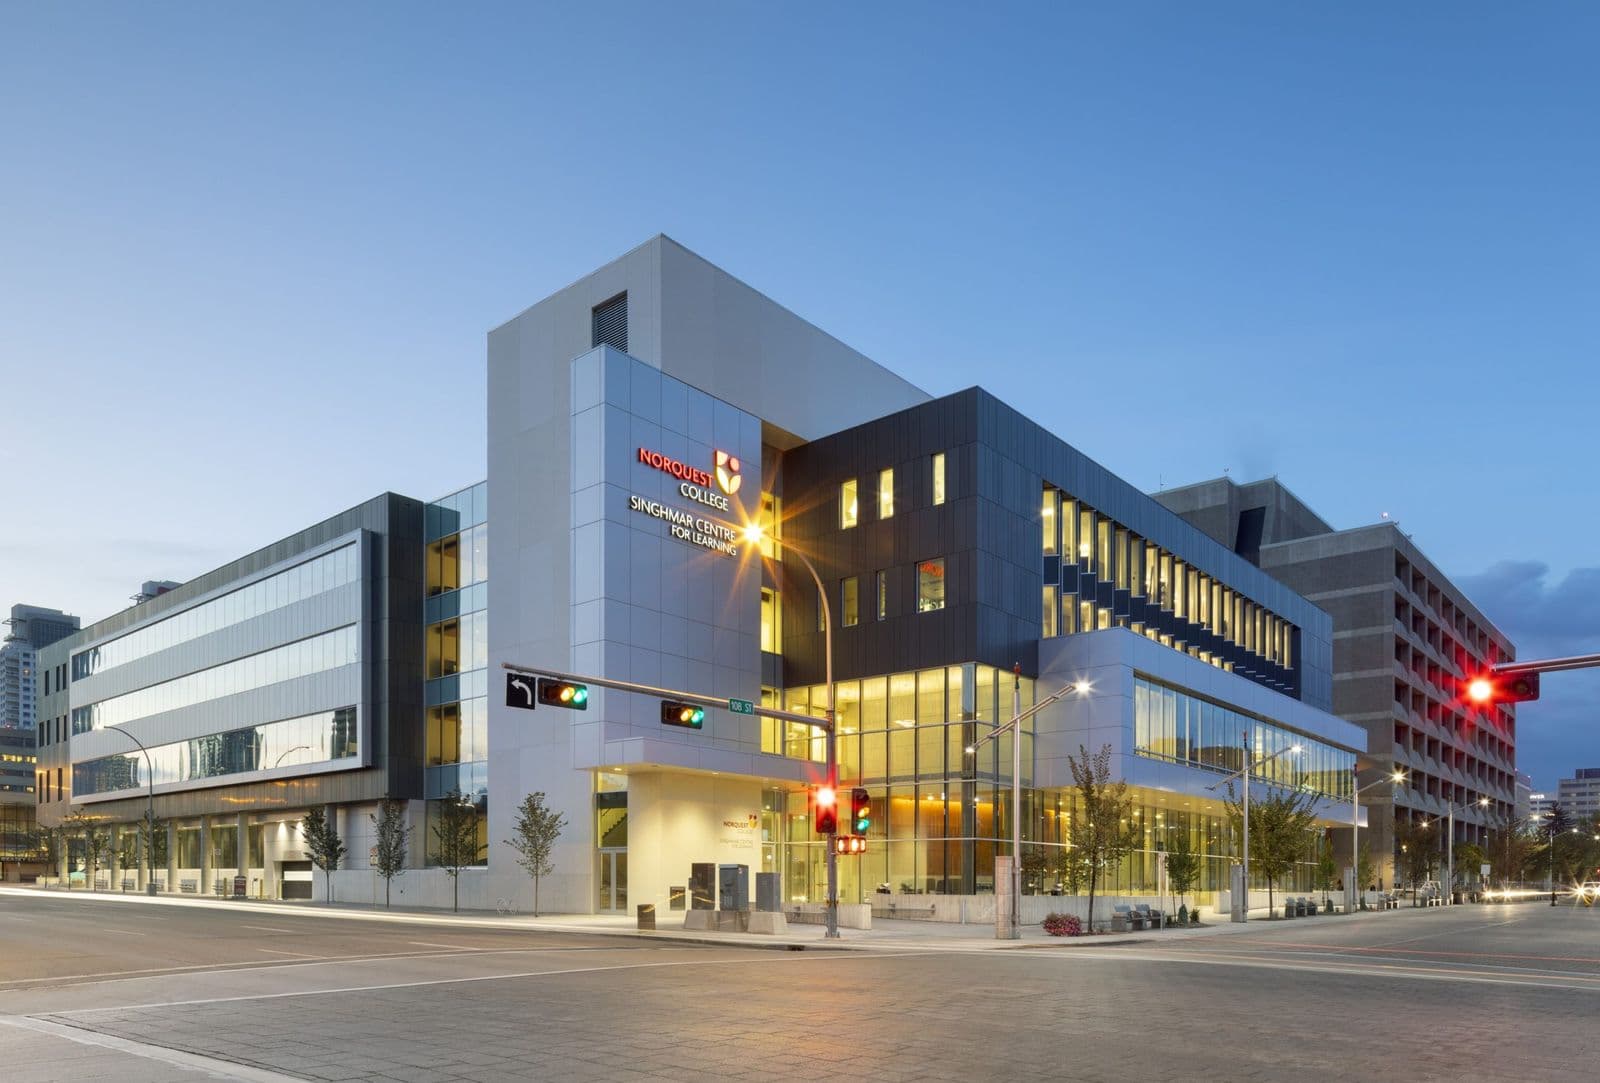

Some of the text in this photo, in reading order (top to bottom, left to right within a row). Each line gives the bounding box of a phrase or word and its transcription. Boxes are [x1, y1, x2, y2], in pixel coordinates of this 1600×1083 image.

[638, 447, 713, 488] NORQUEST
[680, 482, 729, 511] COLLEGE
[629, 495, 736, 541] SINGHMAR CENTRE
[671, 525, 736, 556] FOR LEARNING
